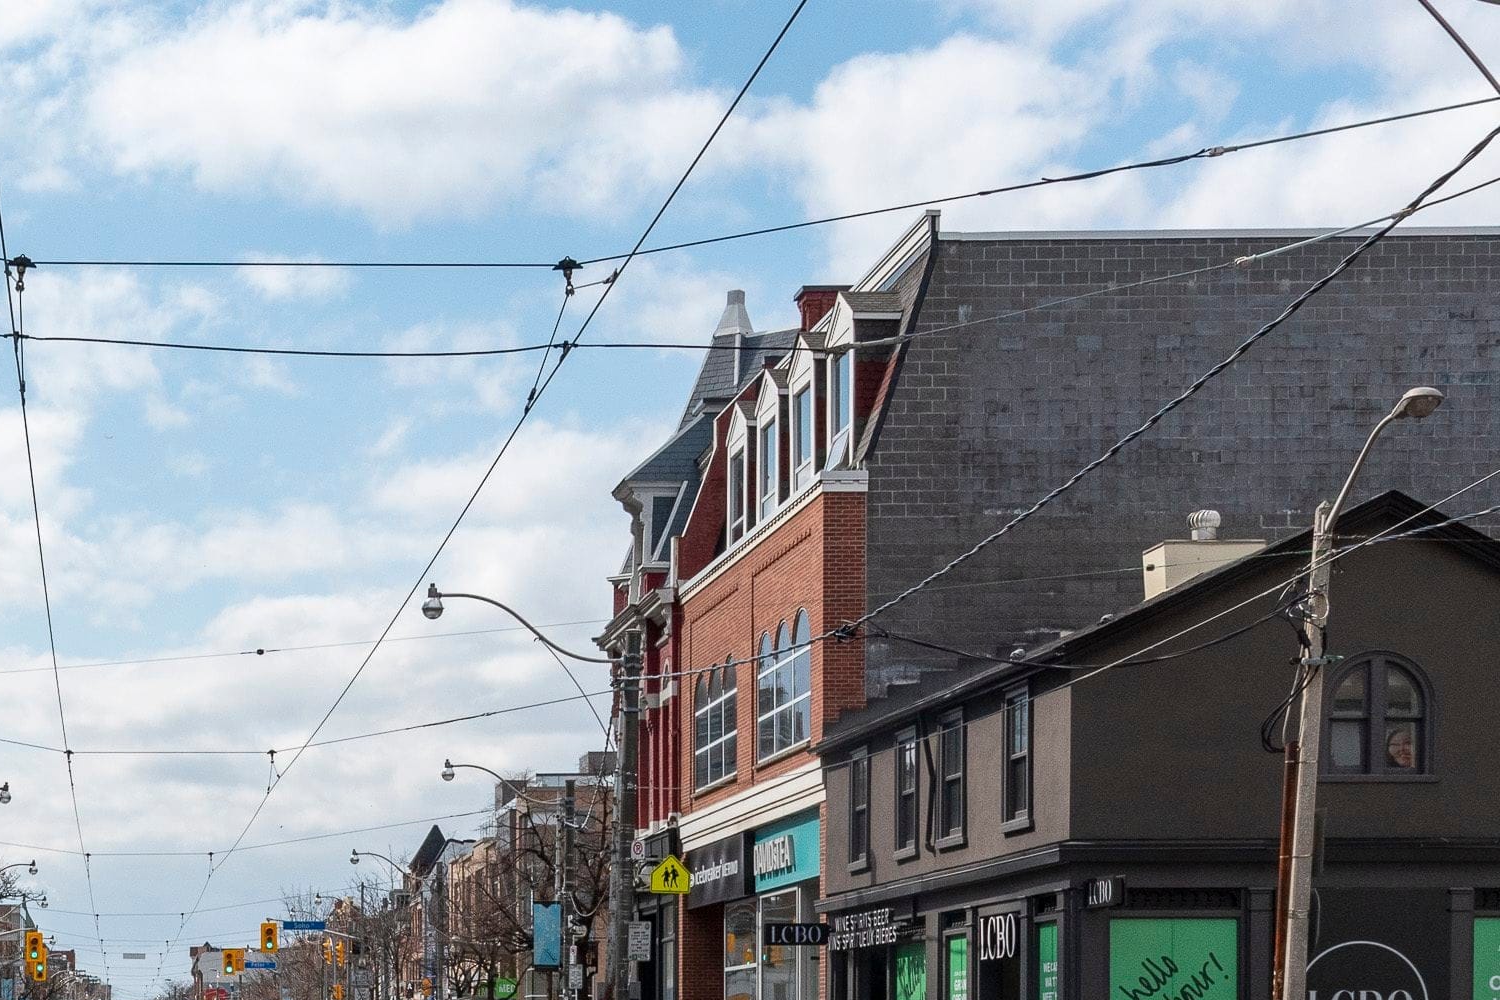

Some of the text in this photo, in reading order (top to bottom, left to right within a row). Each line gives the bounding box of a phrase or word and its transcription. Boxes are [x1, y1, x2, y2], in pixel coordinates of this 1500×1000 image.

[1088, 878, 1113, 906] LCBO
[770, 925, 823, 944] LCBO
[979, 912, 1017, 961] LCBO
